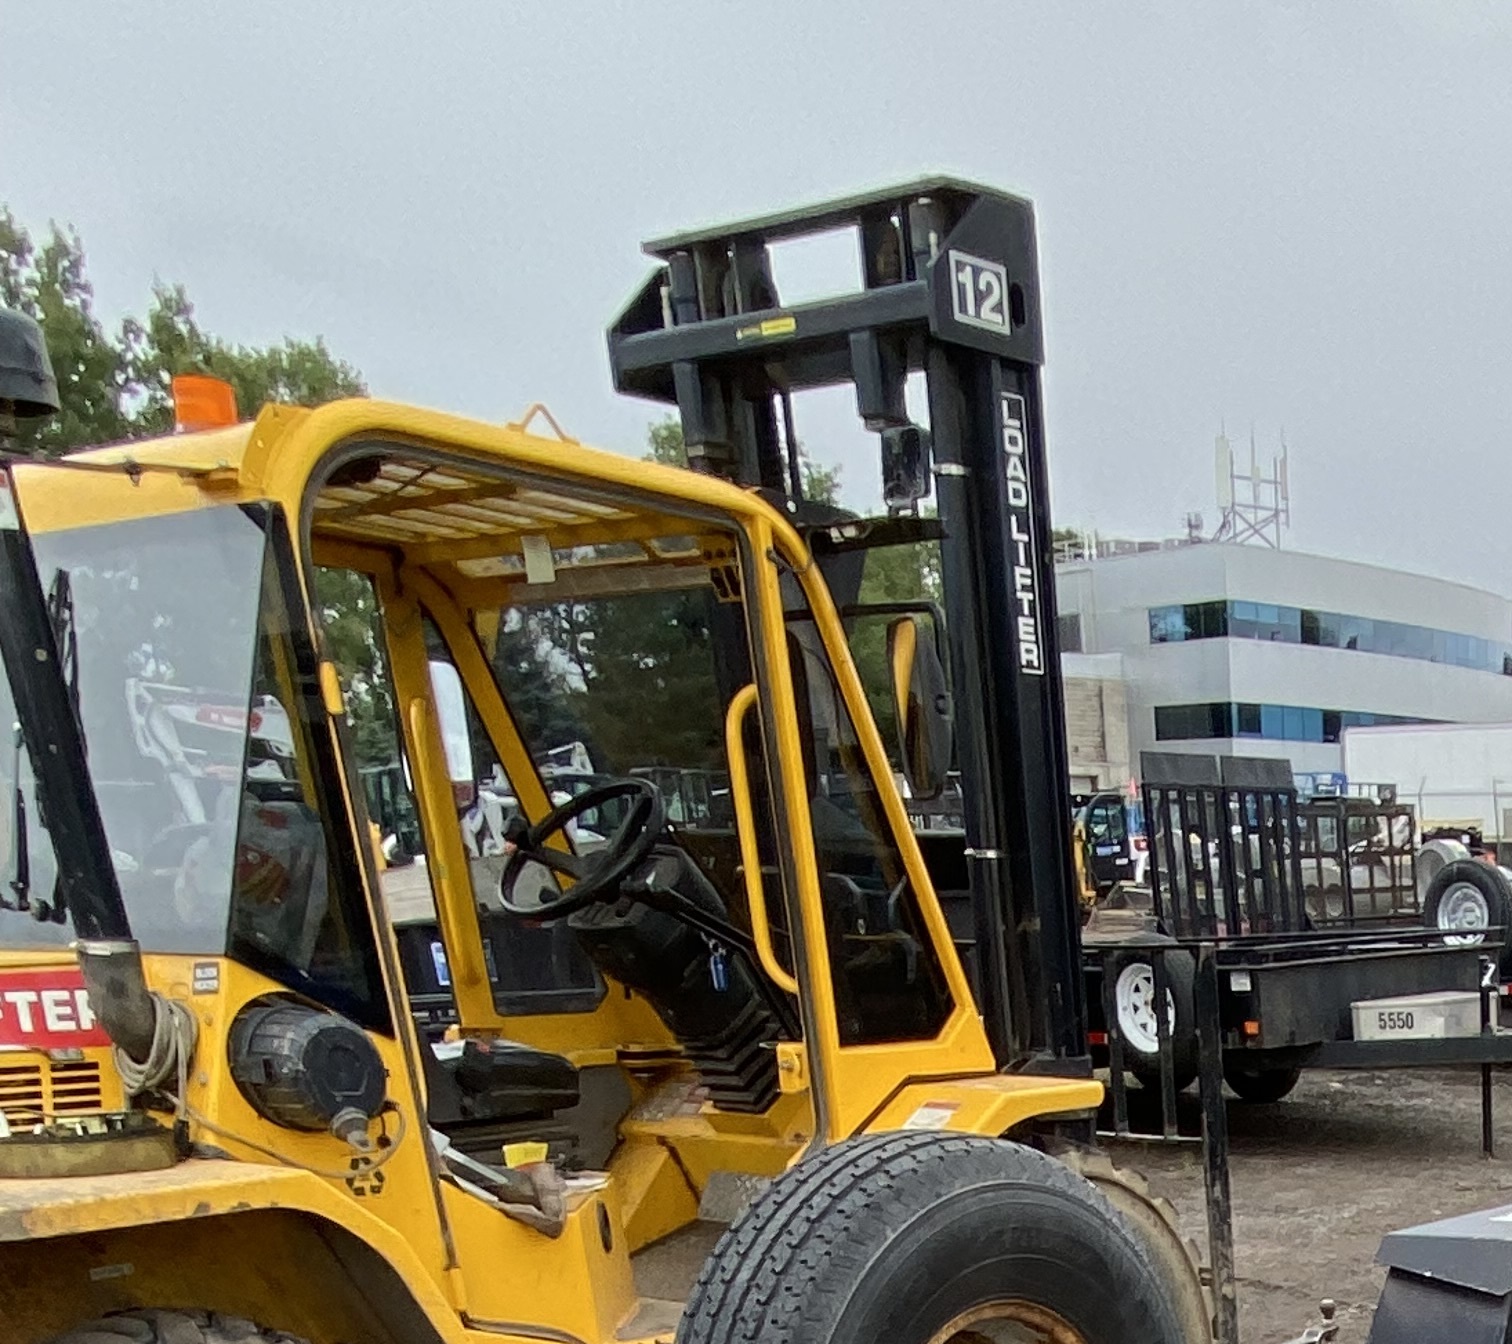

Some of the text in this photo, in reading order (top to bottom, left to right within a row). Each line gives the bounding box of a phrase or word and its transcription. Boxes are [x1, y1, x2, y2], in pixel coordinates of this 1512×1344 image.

[957, 264, 1004, 325] 12
[1002, 400, 1039, 668] LOAD LIFTER
[1378, 1012, 1414, 1030] 5550
